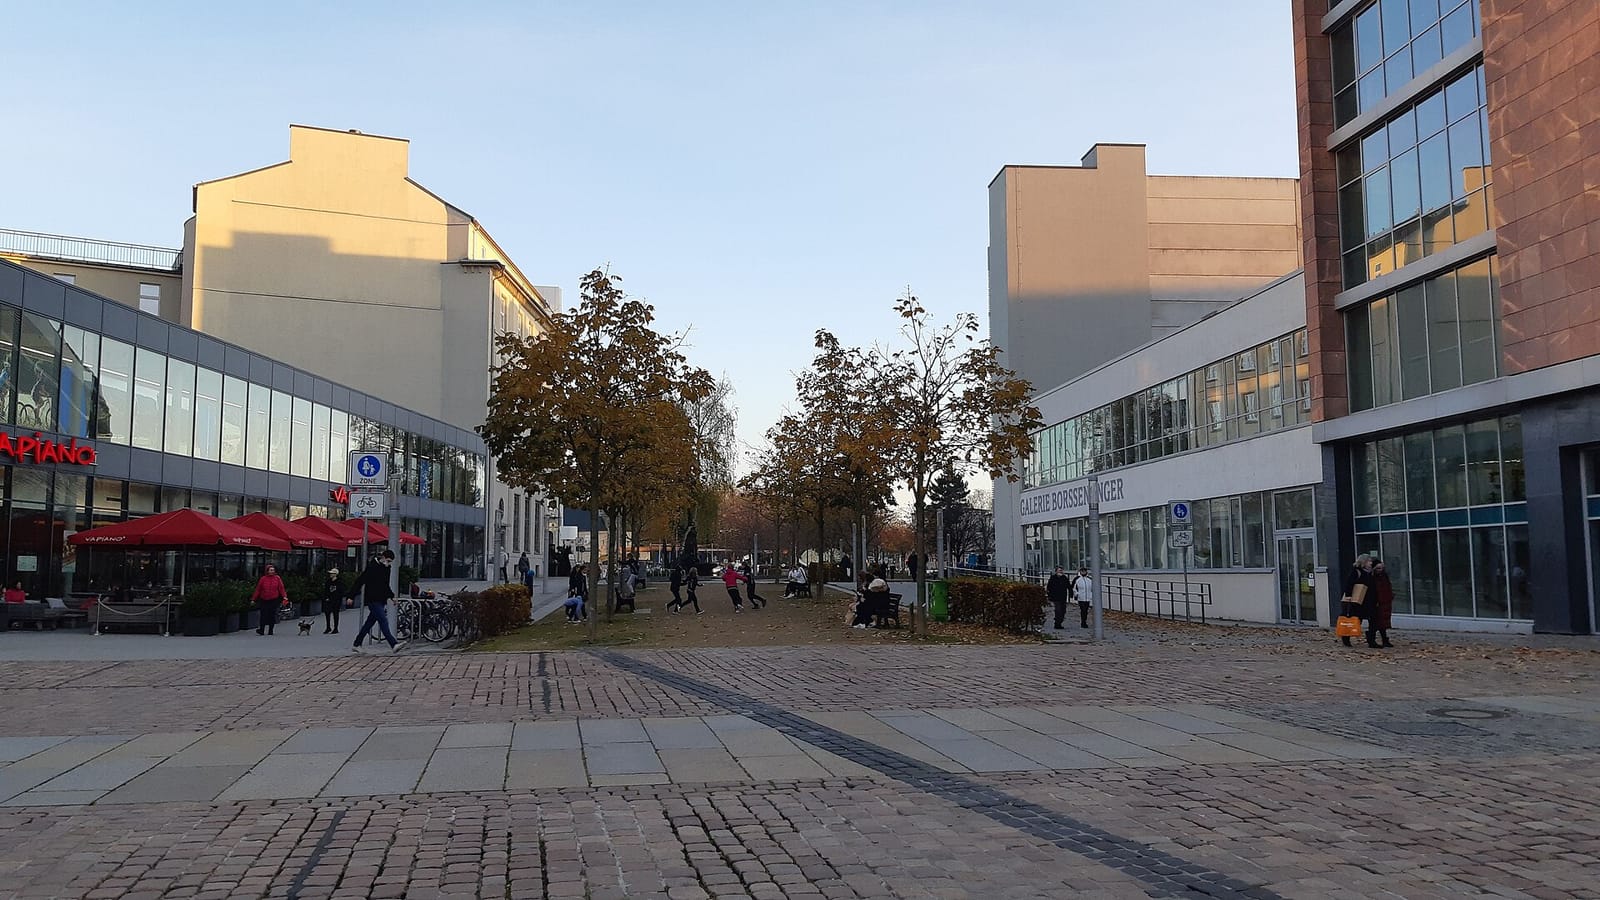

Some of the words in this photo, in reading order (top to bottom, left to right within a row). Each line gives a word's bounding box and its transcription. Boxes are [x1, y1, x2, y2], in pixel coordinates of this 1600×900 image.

[0, 431, 96, 467] APIANO
[1020, 493, 1051, 516] GALERIE
[1051, 478, 1125, 512] BORSSENNGER
